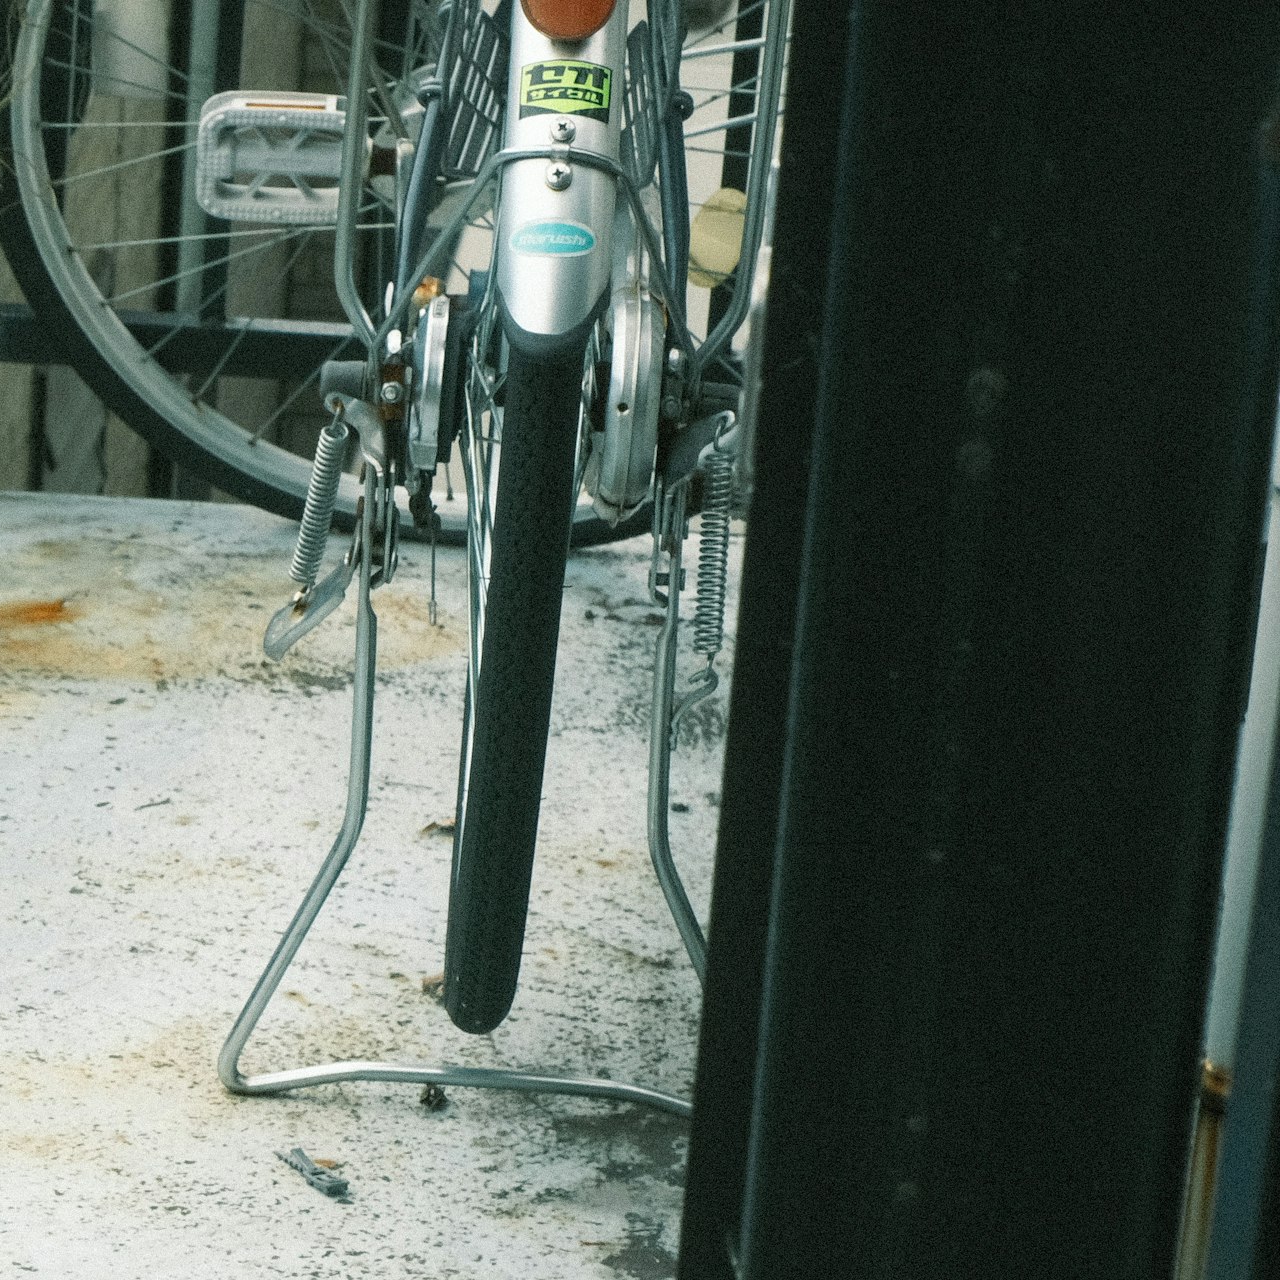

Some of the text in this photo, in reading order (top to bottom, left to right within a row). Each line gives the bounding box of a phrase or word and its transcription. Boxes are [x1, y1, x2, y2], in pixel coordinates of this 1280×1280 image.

[525, 64, 609, 90] セオ
[529, 88, 600, 103] サイクル
